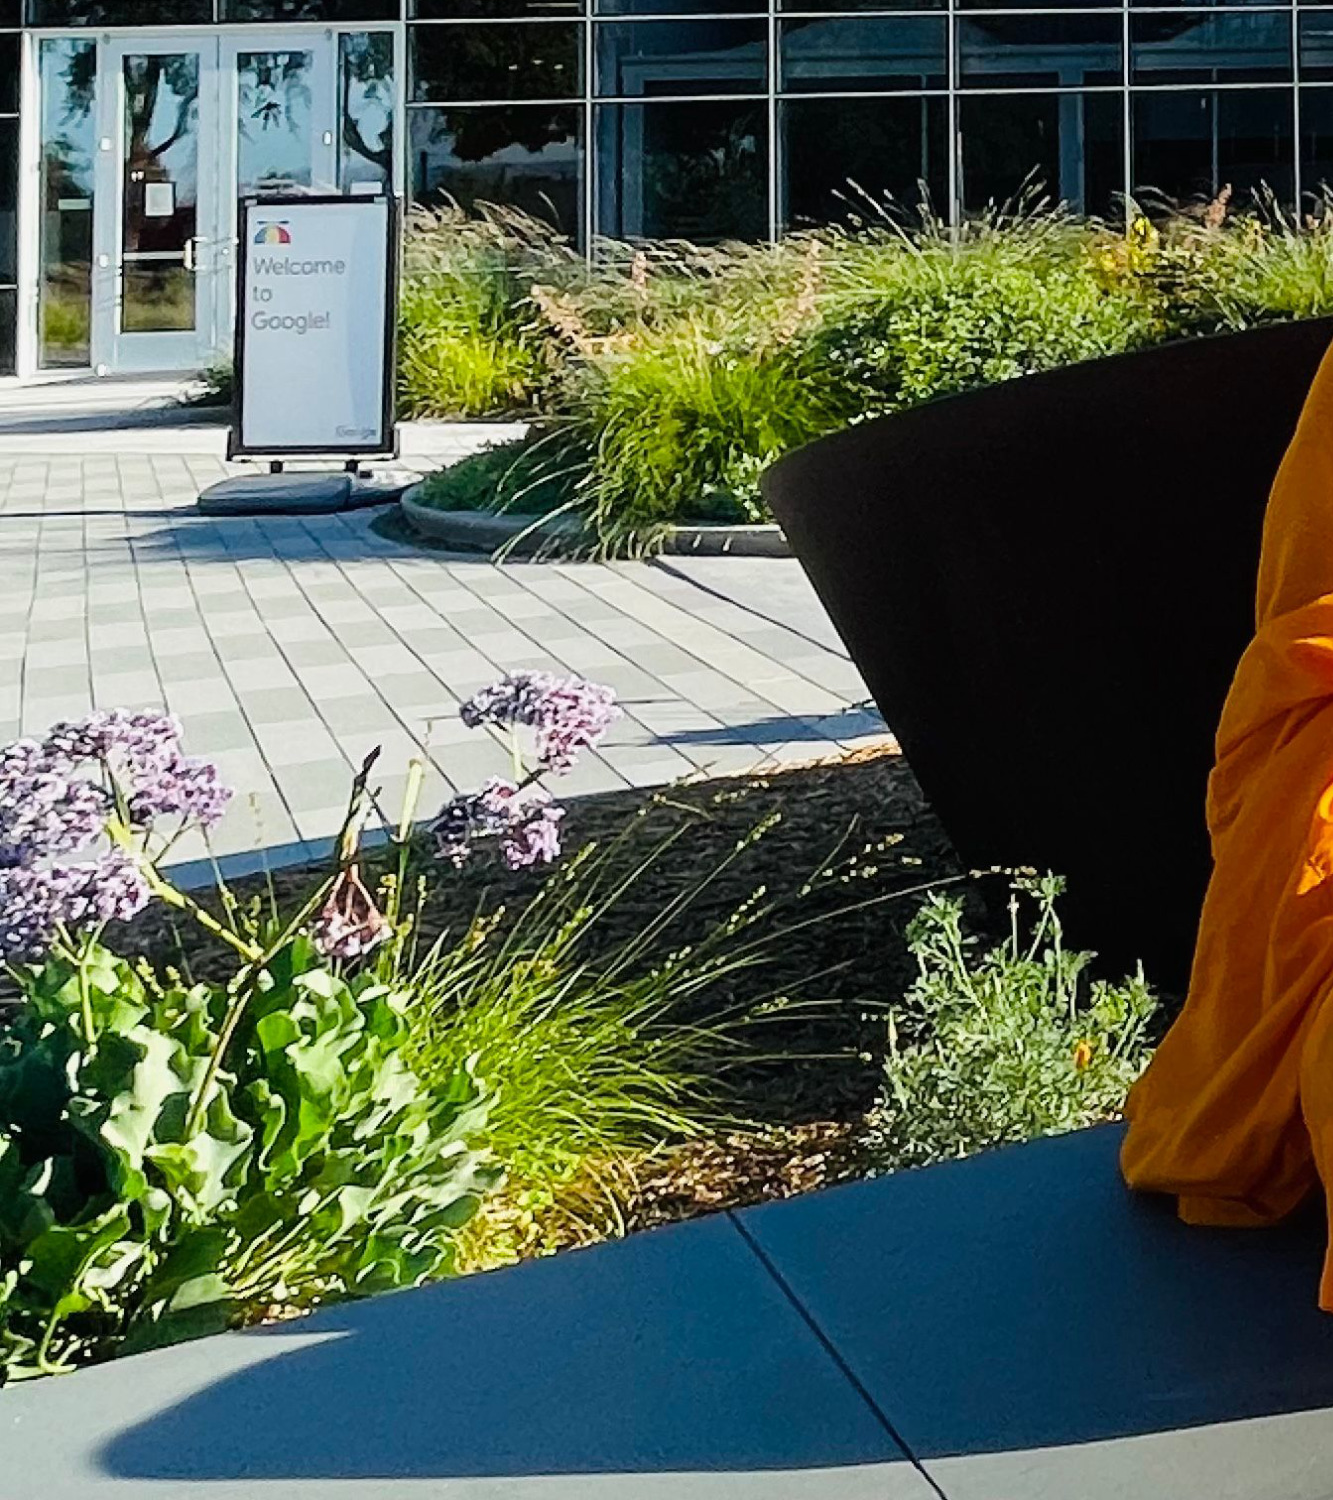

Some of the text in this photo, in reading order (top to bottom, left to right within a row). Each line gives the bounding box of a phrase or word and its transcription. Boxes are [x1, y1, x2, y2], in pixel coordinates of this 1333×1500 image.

[253, 257, 345, 275] Welcome
[253, 286, 272, 302] to
[252, 310, 329, 334] Google!
